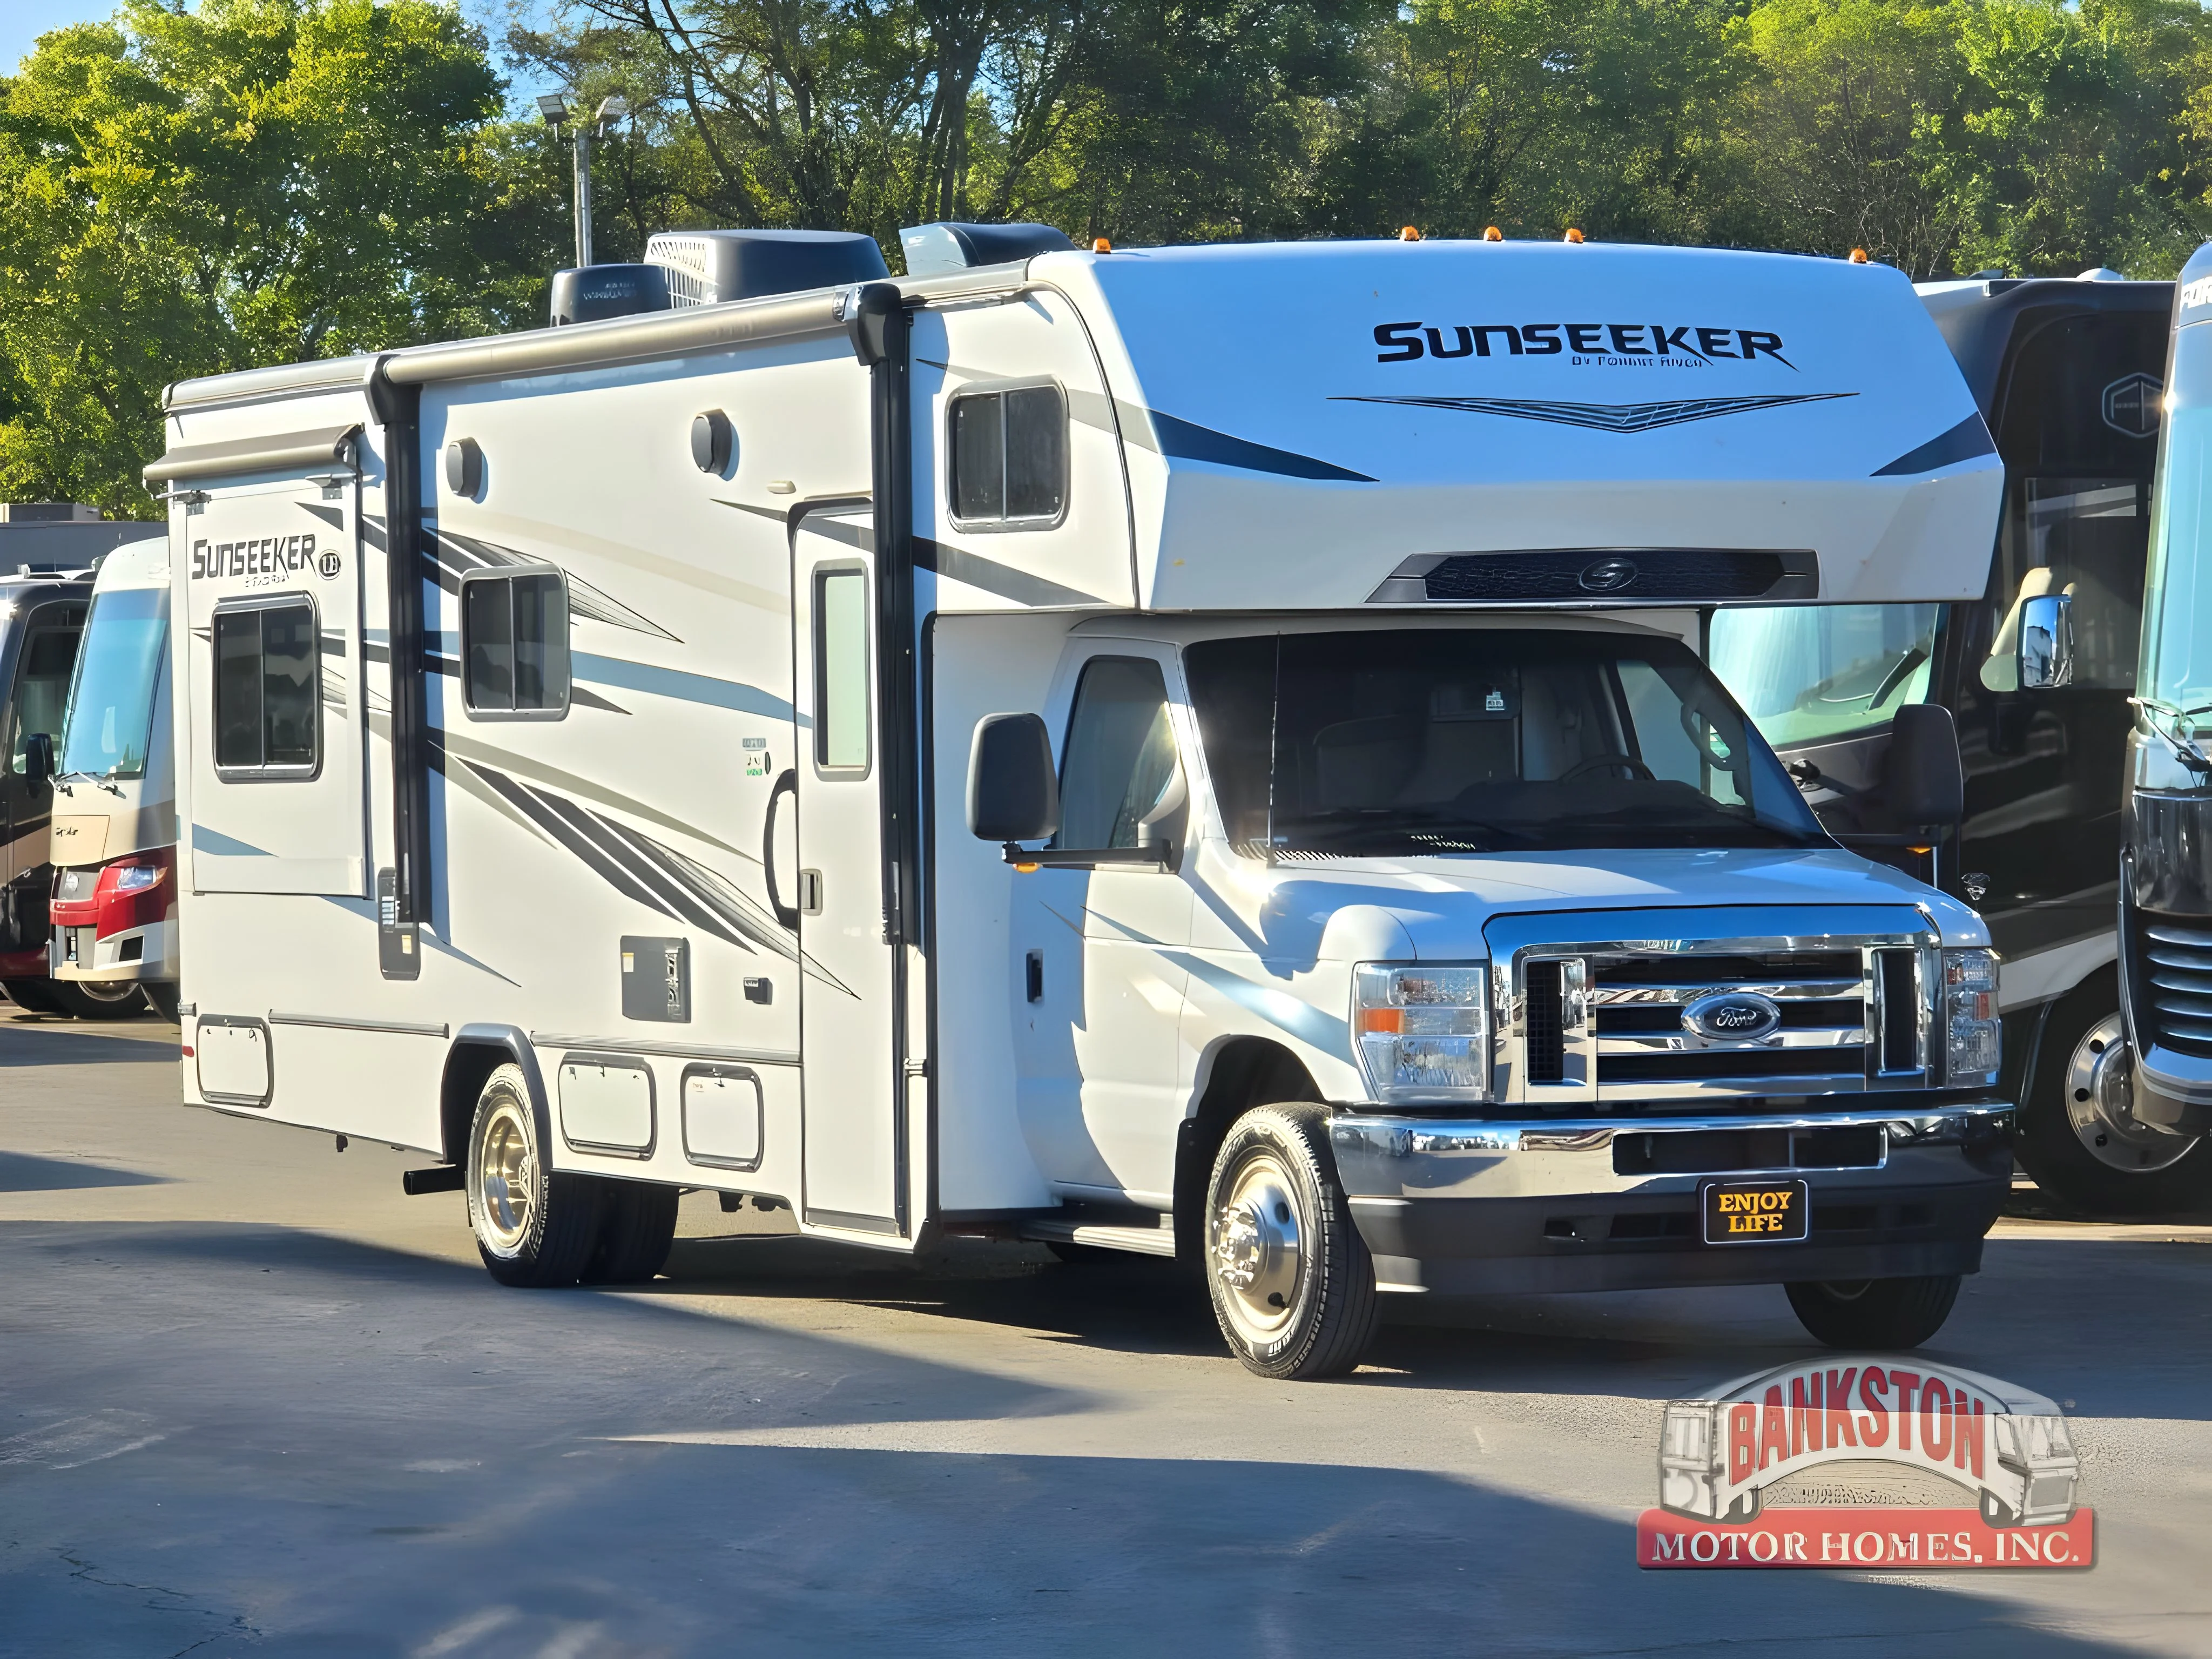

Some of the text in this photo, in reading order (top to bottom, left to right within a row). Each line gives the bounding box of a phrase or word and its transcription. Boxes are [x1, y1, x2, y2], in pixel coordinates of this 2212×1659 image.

[1374, 321, 1800, 373] SUNSEEKER
[192, 534, 318, 579] SUNSEEKER
[1718, 1191, 1793, 1214] ENJOY
[1728, 1213, 1783, 1232] LIFE
